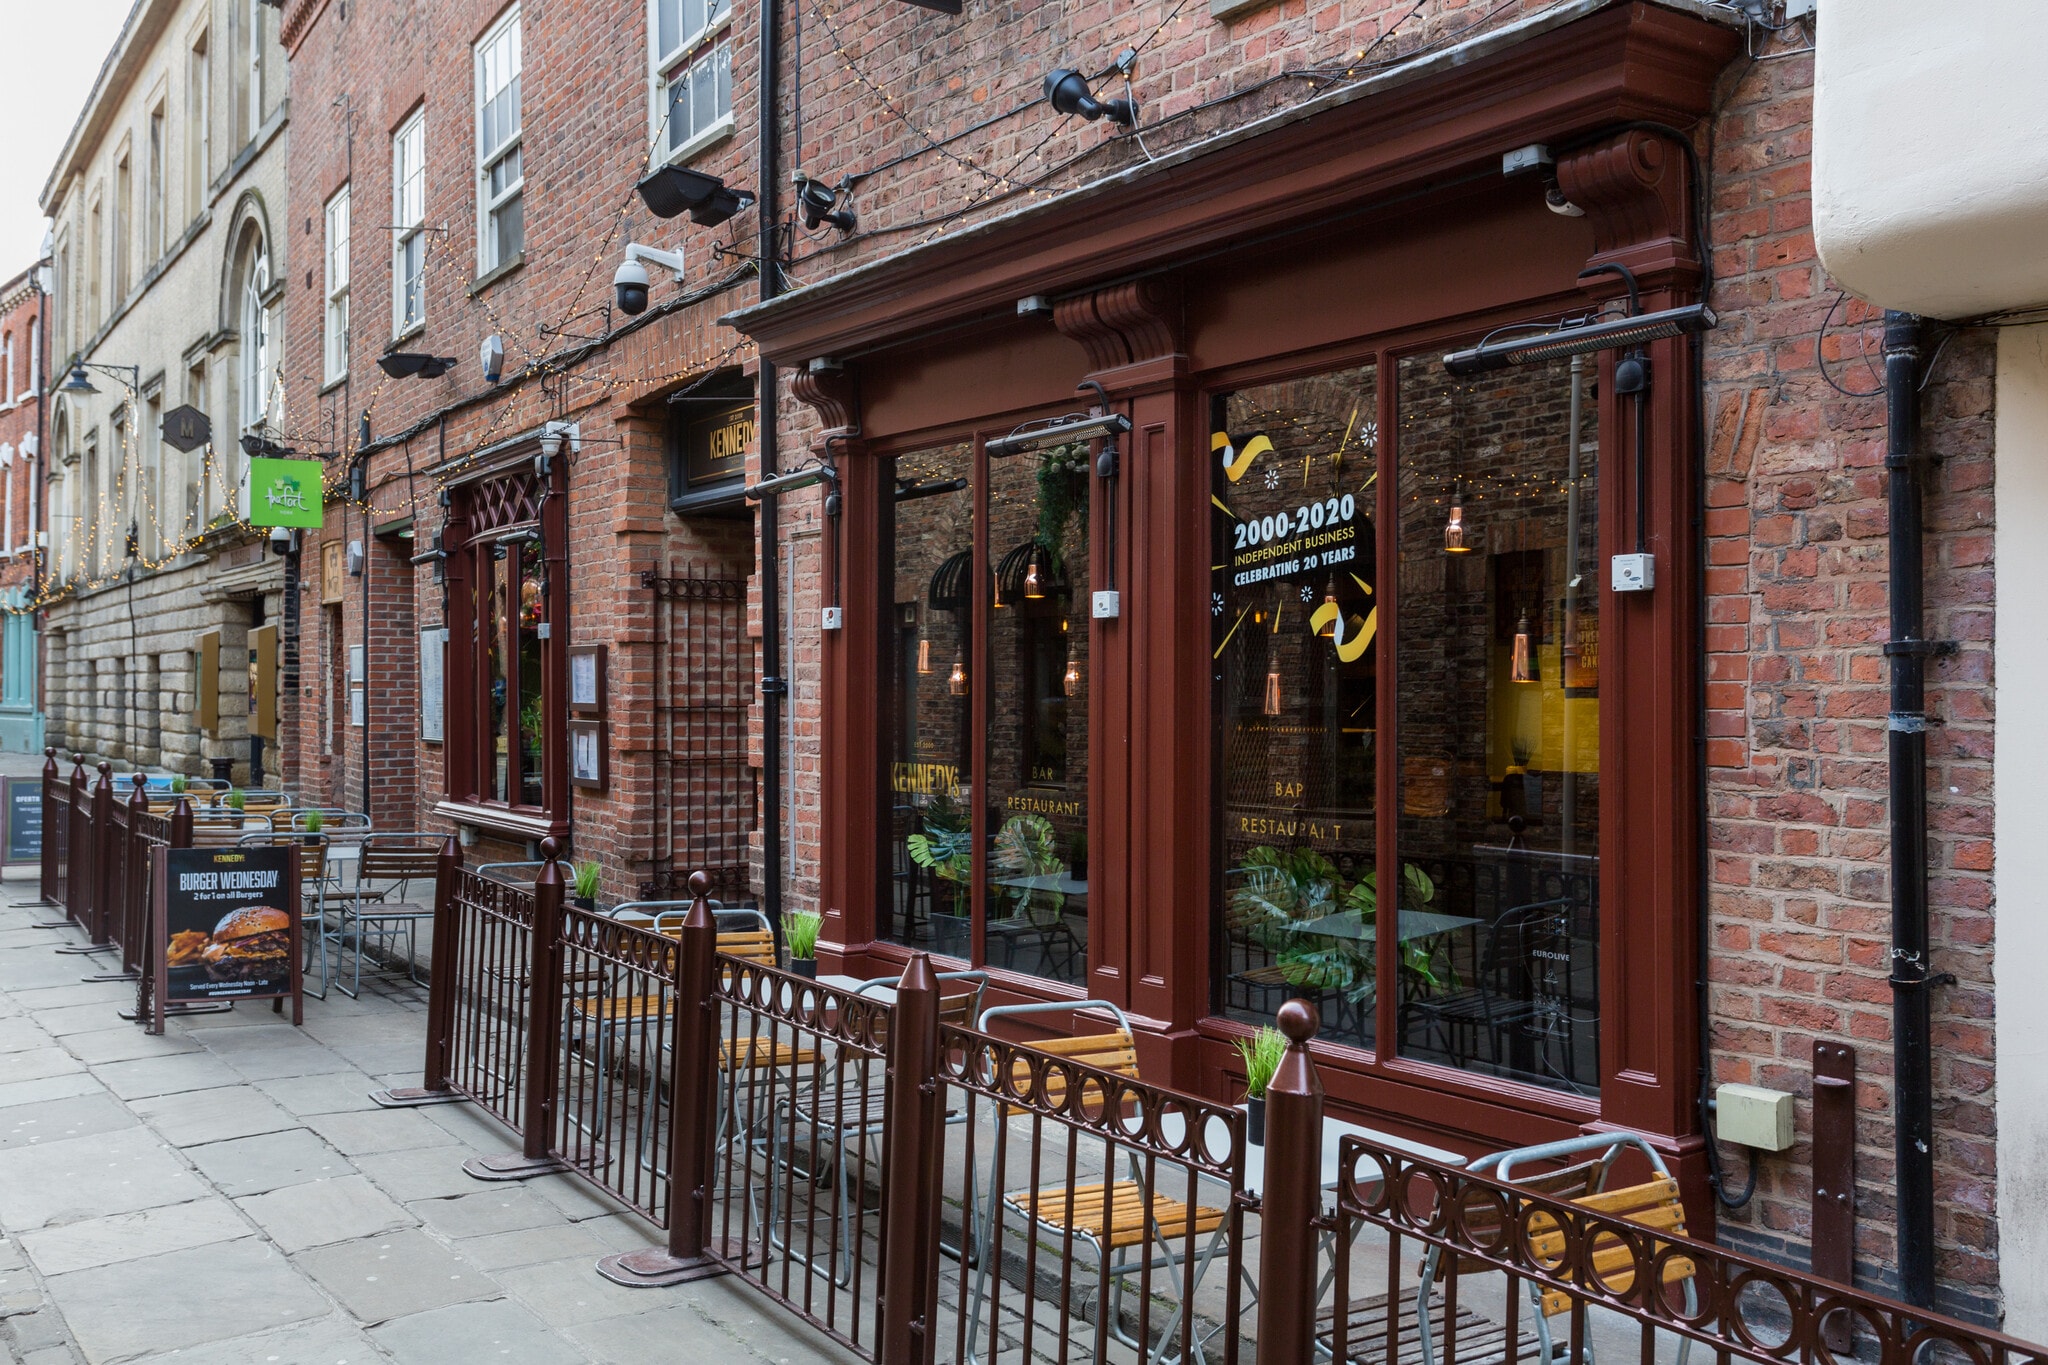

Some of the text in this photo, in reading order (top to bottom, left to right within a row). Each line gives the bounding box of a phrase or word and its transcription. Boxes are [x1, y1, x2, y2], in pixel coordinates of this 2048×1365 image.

[180, 417, 194, 439] M
[1234, 494, 1355, 549] 2000-2020
[1234, 526, 1355, 567] INDEPENDENT BUSINESS
[1234, 545, 1355, 587] CELEBRATING 20 YEARS
[1581, 656, 1598, 668] CAK
[1032, 766, 1053, 780] BAR
[1007, 796, 1079, 815] RESTAURANT
[180, 870, 278, 891] BURGER WEDNESDAY
[193, 892, 199, 900] 2
[200, 891, 211, 900] for
[226, 891, 236, 899] all
[236, 891, 263, 900] Burgers
[501, 887, 535, 928] BAR
[1533, 949, 1570, 961] EUROLIVE
[207, 982, 218, 990] Every
